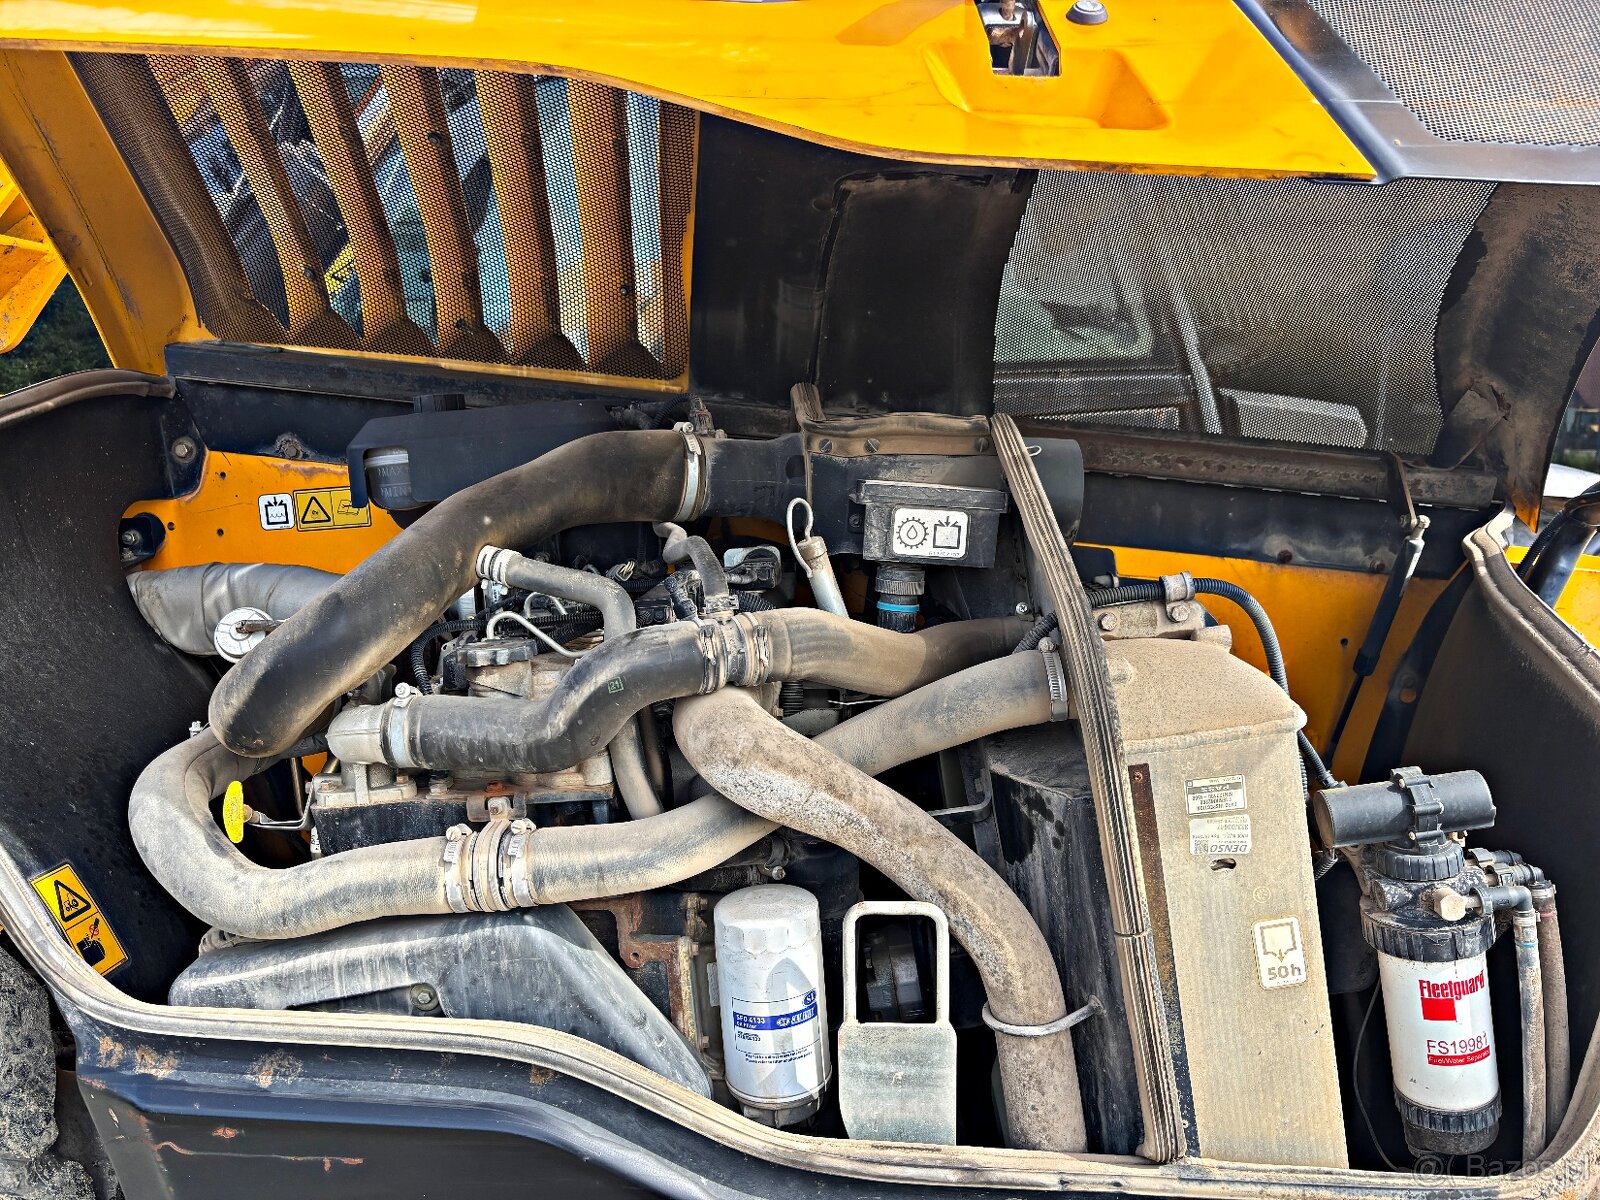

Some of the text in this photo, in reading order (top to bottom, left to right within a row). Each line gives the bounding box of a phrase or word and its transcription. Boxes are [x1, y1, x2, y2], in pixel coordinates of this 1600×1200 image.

[377, 465, 401, 477] MAX
[1200, 785, 1230, 793] PASS
[1210, 844, 1248, 853] DENSO
[1418, 970, 1485, 1000] Fleetguard
[1426, 1031, 1488, 1055] FS19981
